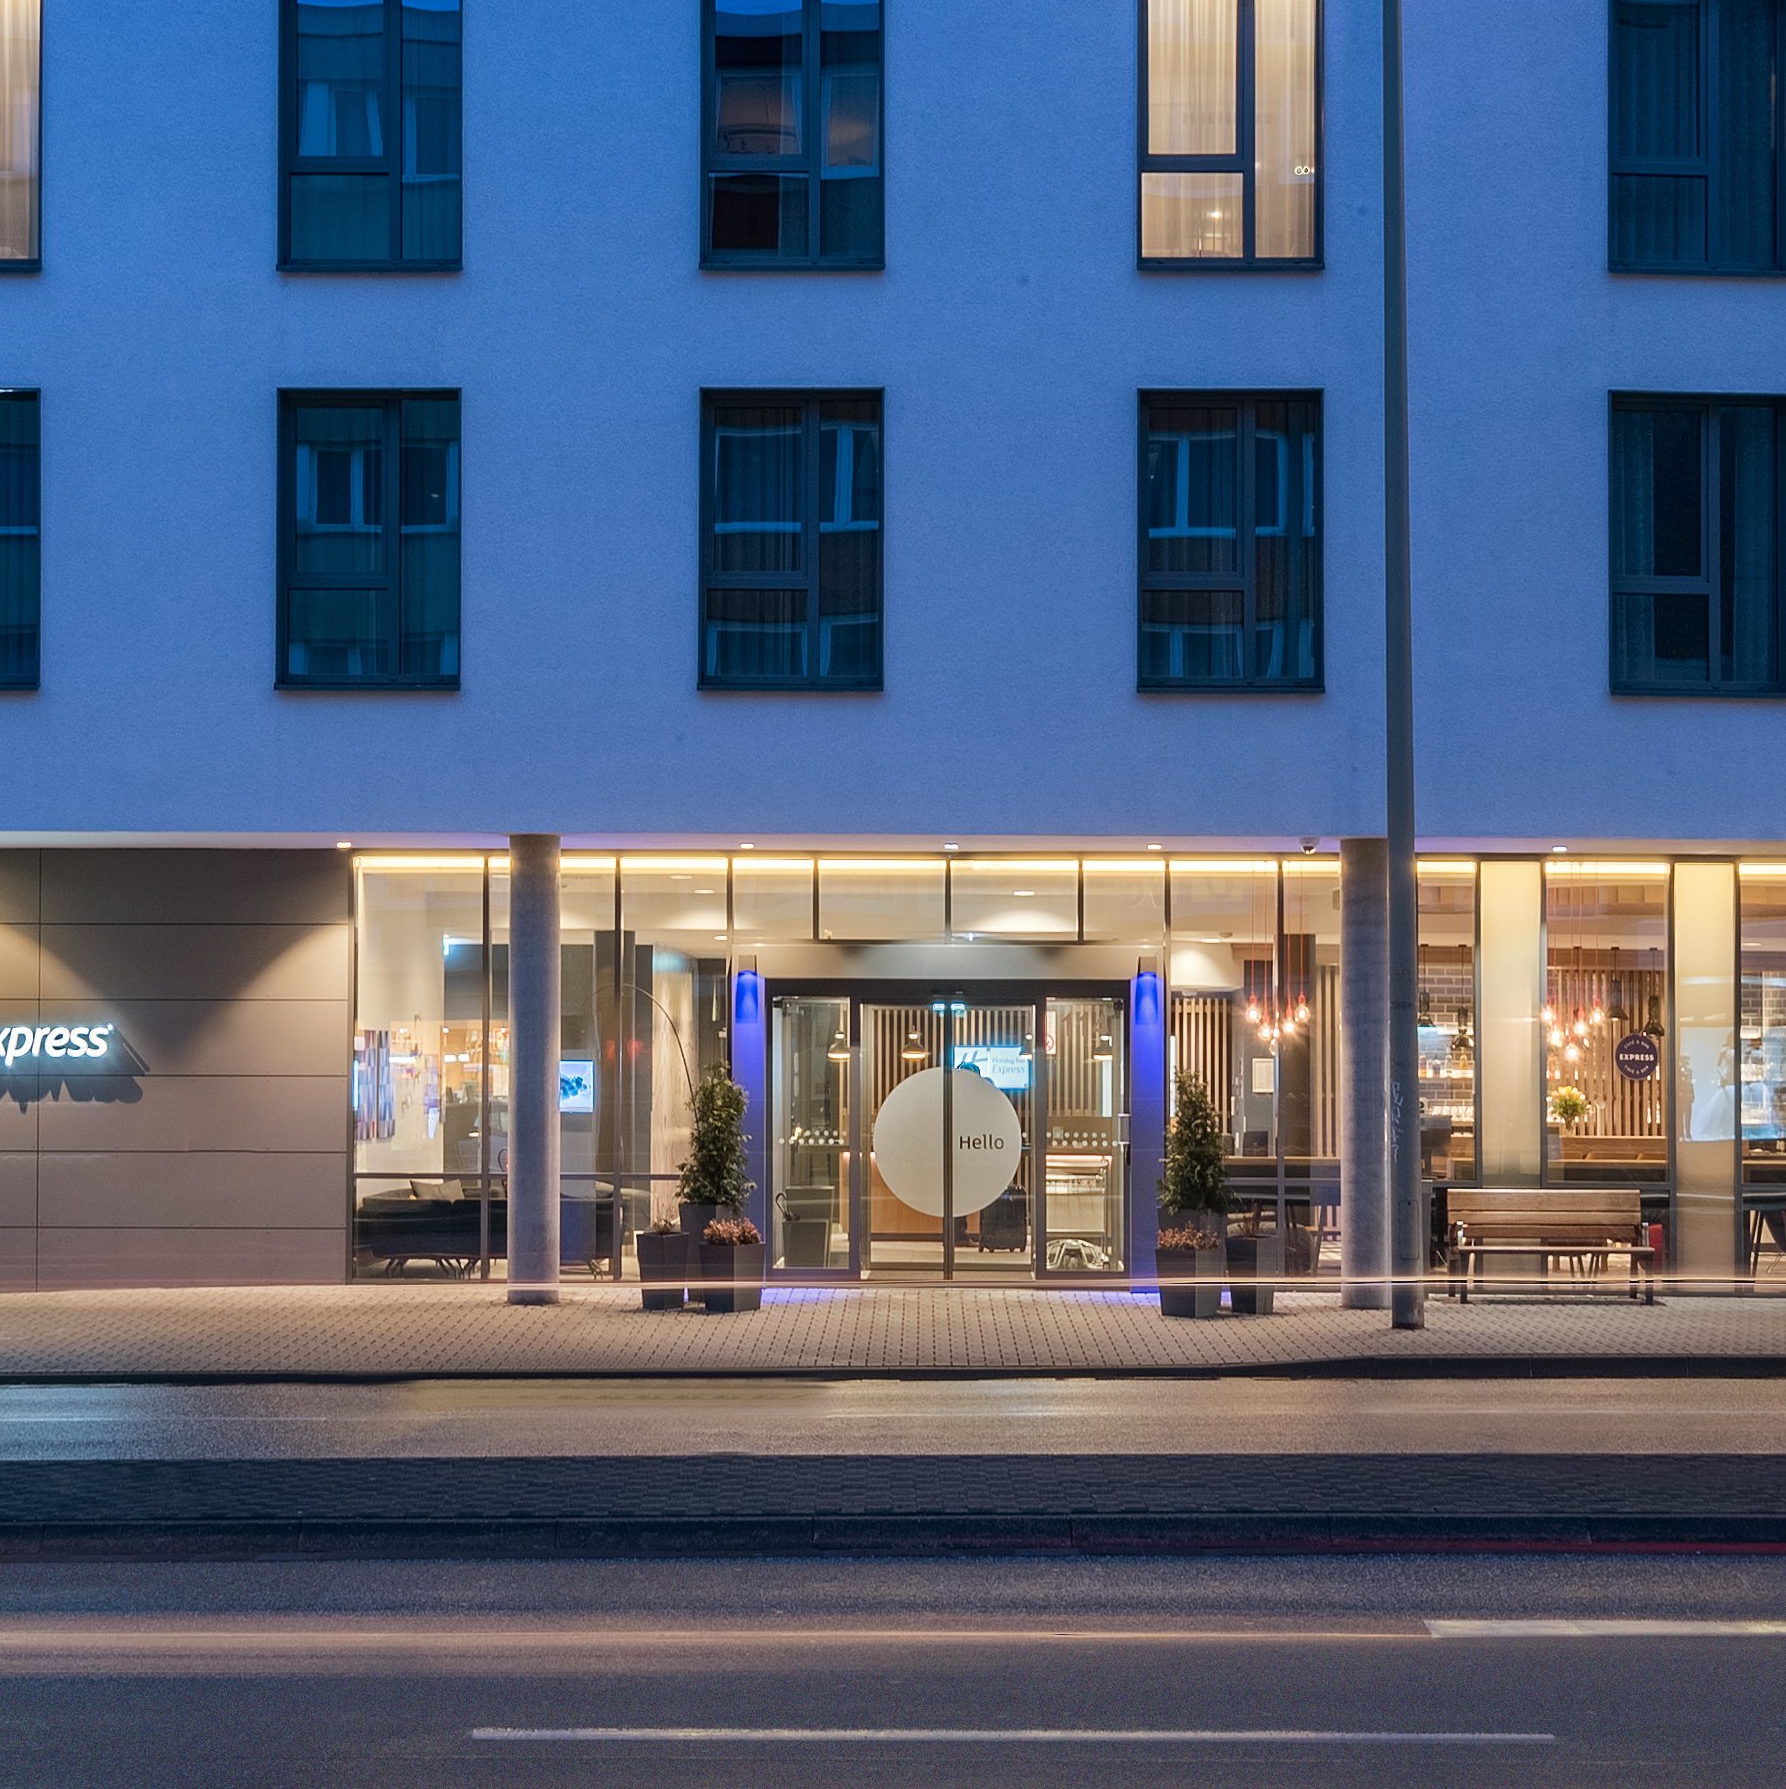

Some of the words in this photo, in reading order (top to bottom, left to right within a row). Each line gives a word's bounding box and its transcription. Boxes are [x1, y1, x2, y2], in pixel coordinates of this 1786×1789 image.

[1619, 1053, 1655, 1061] EXPRESS
[991, 1063, 1026, 1076] Express
[959, 1134, 1004, 1150] Hello
